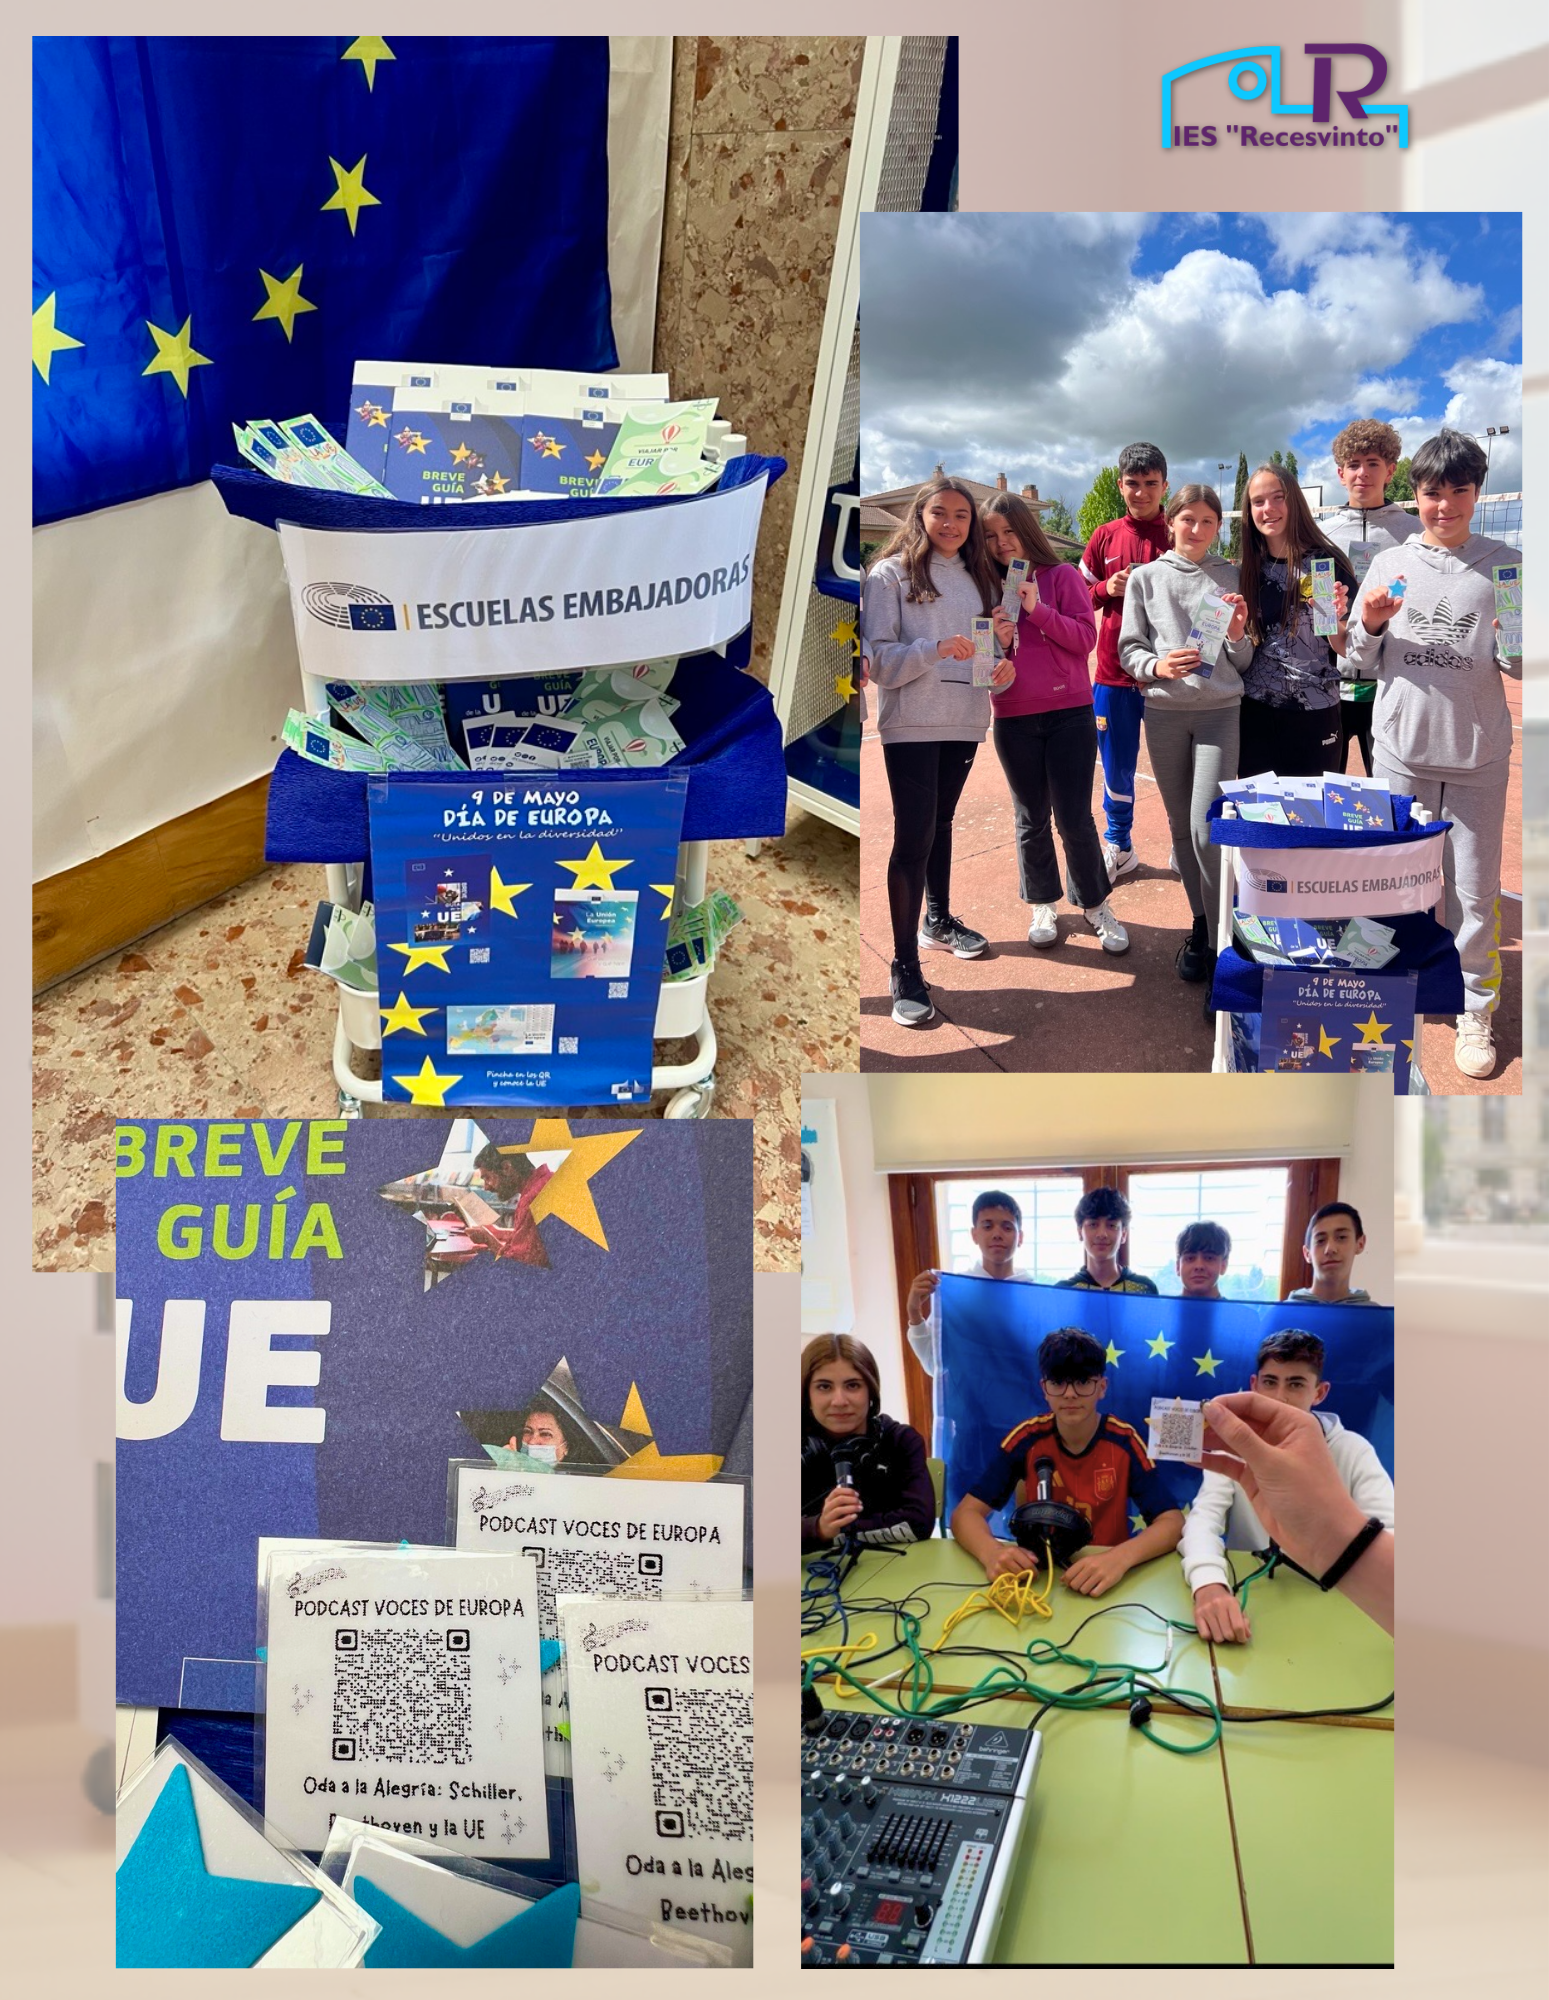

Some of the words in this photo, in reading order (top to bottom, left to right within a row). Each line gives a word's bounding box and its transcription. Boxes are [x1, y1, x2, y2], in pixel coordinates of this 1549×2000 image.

[627, 458, 656, 467] EUR
[422, 470, 466, 482] BREVE
[559, 476, 600, 487] BREV
[432, 482, 465, 494] GUÍA
[416, 594, 556, 630] ESCUELAS
[563, 553, 751, 620] EMBAJADORAS
[1403, 648, 1475, 671] adidas
[544, 680, 572, 691] GUÍA
[471, 790, 484, 806] 9
[492, 791, 516, 805] DE
[522, 790, 580, 807] MAYO
[443, 803, 486, 828] DÍA
[494, 810, 519, 827] DE
[527, 807, 613, 827] EUROPA
[1342, 811, 1363, 820] BREVE
[496, 832, 516, 840] en
[519, 830, 536, 839] la
[1297, 877, 1359, 894] ESCUELAS
[1362, 866, 1441, 892] EMBAJADORAS
[436, 911, 462, 922] UE
[1316, 937, 1337, 951] UE
[1312, 977, 1320, 986] 9
[1322, 978, 1335, 987] DE
[1337, 978, 1366, 989] MAYO
[1298, 984, 1319, 998] DÍA
[1323, 988, 1336, 999] DE
[1339, 989, 1382, 1001] EUROPA
[1290, 1051, 1304, 1059] UE
[539, 1071, 551, 1080] QR
[116, 1120, 348, 1177] BREVE
[157, 1185, 344, 1260] GUÍA
[116, 1298, 332, 1443] UE
[479, 1514, 557, 1536] PODCAST
[563, 1519, 621, 1539] VOCES
[627, 1522, 647, 1540] DE
[652, 1523, 721, 1544] EUROPA
[294, 1598, 369, 1617] PODCAST
[375, 1599, 430, 1617] VOCES
[434, 1599, 454, 1617] DE
[459, 1597, 525, 1617] EUROPA
[593, 1653, 680, 1674] PODCAST
[685, 1655, 751, 1675] VOCES
[303, 1776, 336, 1795] Oda
[341, 1781, 350, 1794] a
[355, 1777, 368, 1796] la
[373, 1777, 443, 1799] Alegría:
[429, 1821, 439, 1839] y
[444, 1820, 458, 1836] la
[463, 1819, 485, 1839] UE
[626, 1854, 665, 1876] Oda
[672, 1861, 682, 1876] a
[688, 1858, 703, 1878] la
